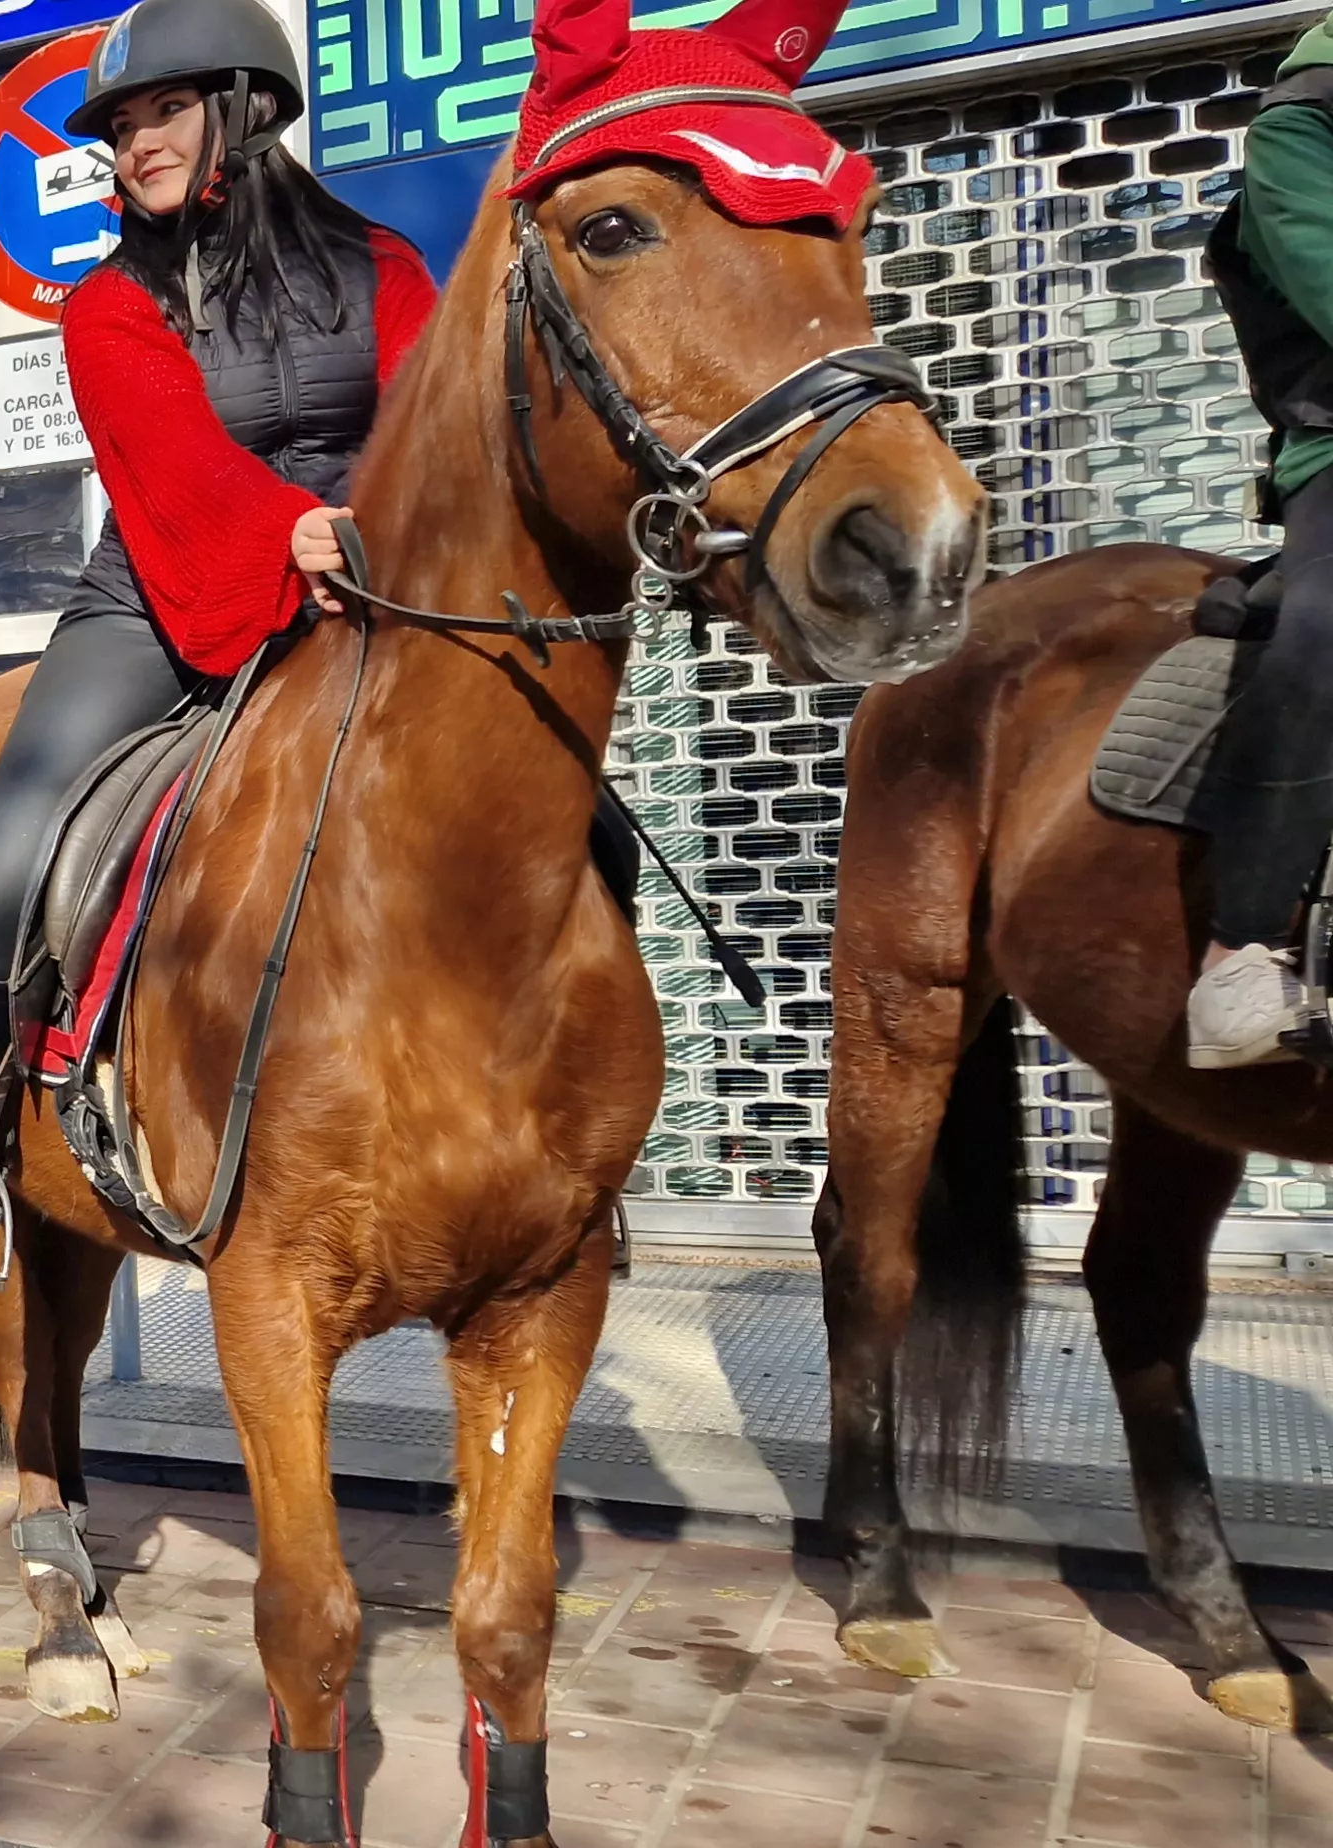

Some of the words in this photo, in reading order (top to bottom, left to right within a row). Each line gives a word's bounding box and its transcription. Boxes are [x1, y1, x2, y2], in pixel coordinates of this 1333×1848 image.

[12, 352, 51, 372] DÍAS
[3, 392, 64, 413] CARGA
[12, 416, 35, 432] DE
[43, 411, 77, 428] 08:0
[4, 438, 14, 453] Y
[24, 434, 46, 451] DE
[55, 430, 84, 446] 16:0
